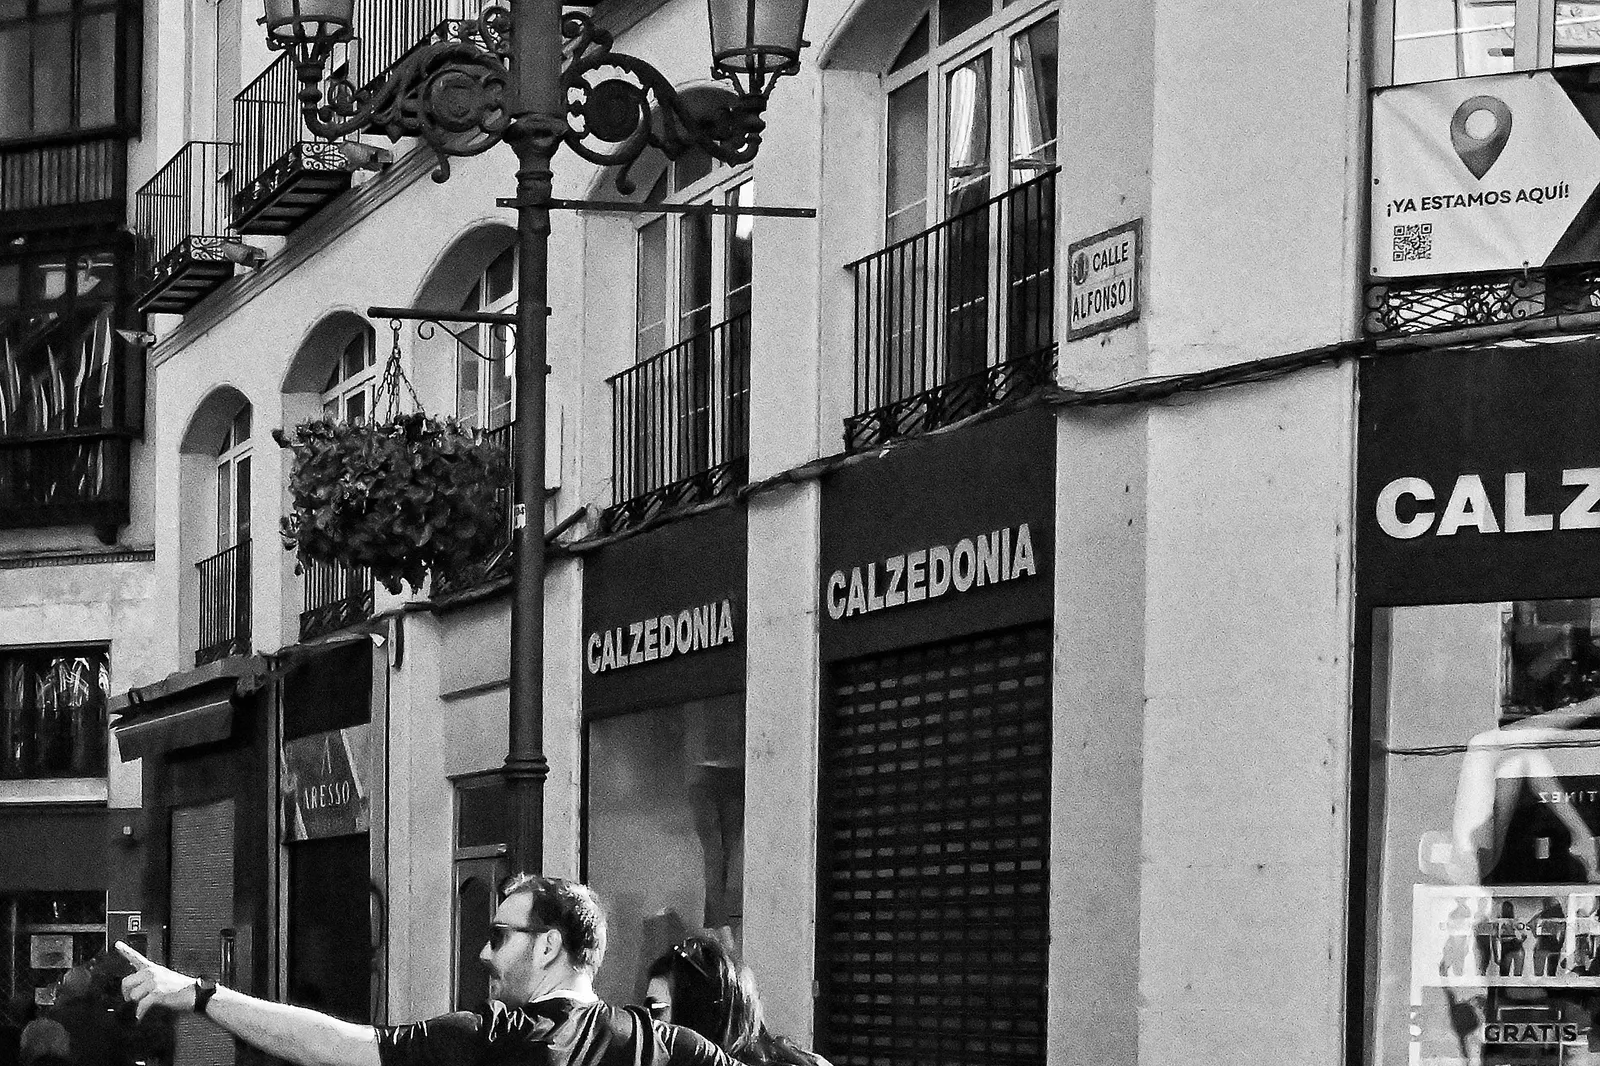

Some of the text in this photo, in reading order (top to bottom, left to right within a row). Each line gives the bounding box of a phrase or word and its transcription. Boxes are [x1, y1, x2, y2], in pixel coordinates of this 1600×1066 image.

[1387, 181, 1569, 217] ¡YA ESTAMOS AQUÍ!
[1093, 241, 1128, 272] CALLE
[1073, 279, 1126, 322] ALFONSO
[1376, 467, 1600, 539] CALZ
[827, 523, 1036, 620] CALZEDONIA
[588, 599, 734, 675] CALZEDONIA
[1485, 1024, 1578, 1043] GRATIS
